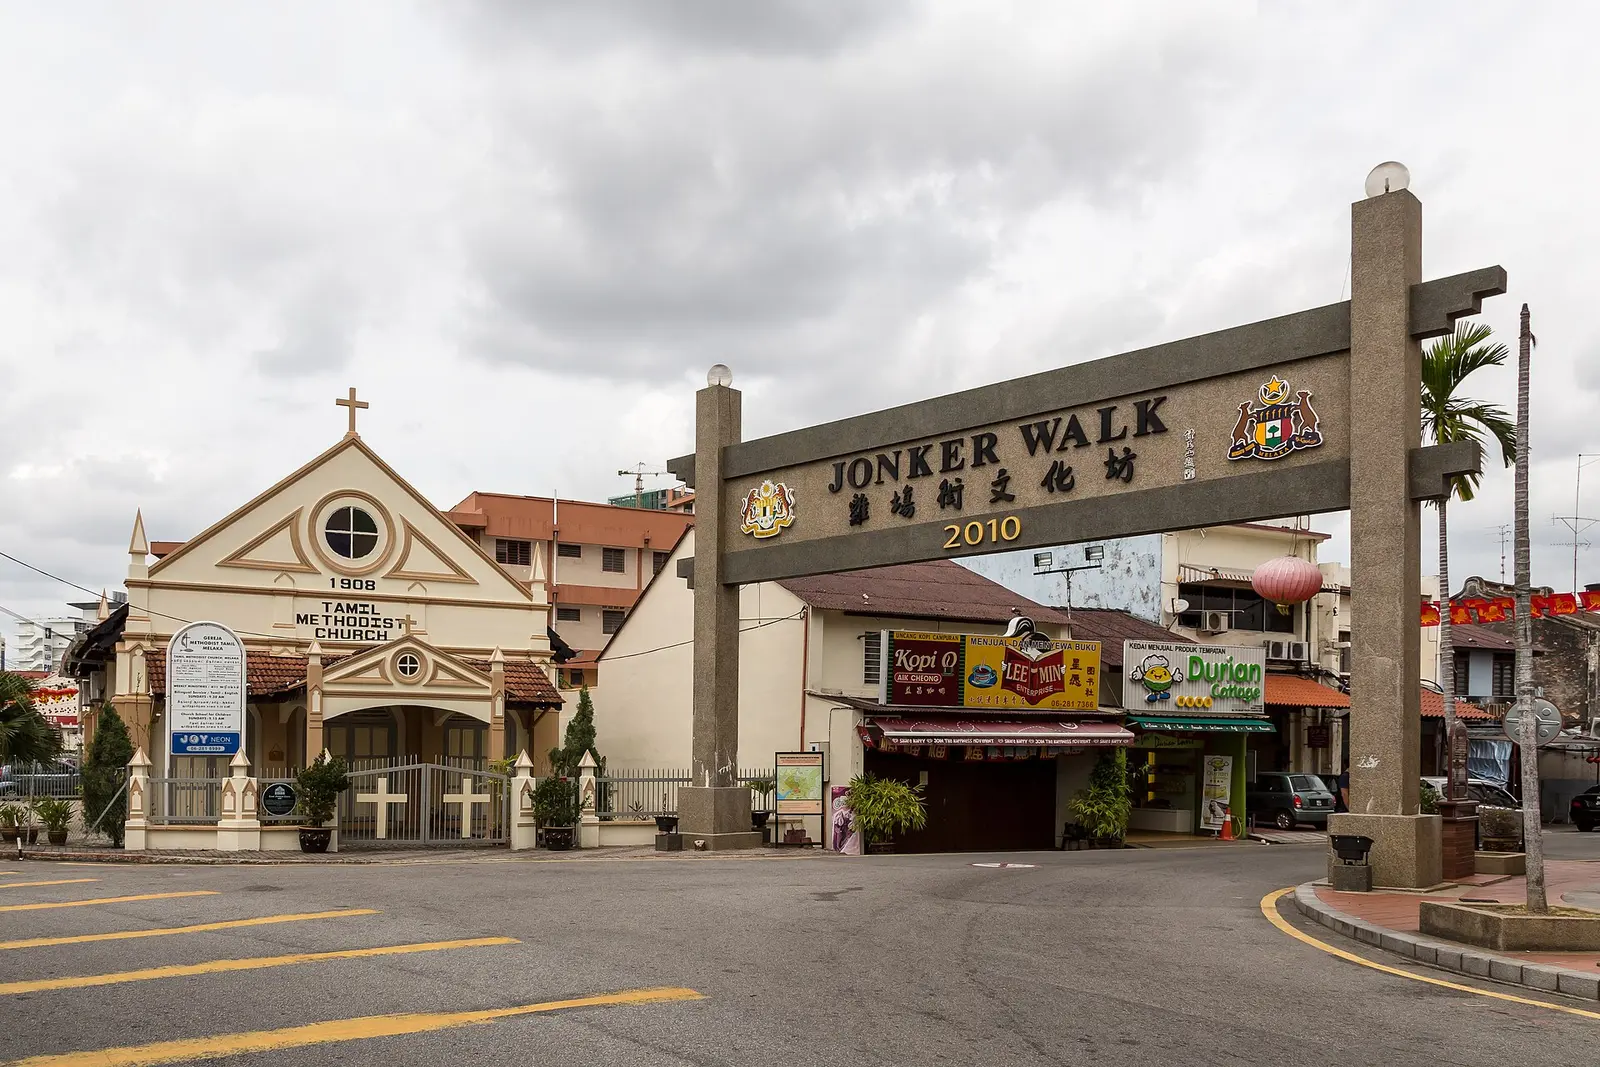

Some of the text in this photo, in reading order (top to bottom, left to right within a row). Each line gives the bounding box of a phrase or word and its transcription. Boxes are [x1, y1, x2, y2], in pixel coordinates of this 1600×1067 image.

[828, 432, 1000, 493] JONKER
[1018, 396, 1169, 457] WALK
[942, 516, 1021, 550] 2010
[330, 577, 376, 590] 1908
[321, 601, 381, 615] TAMIL
[296, 613, 406, 629] METHODIST
[315, 627, 388, 641] CHURCH
[895, 632, 917, 640] UNCANG
[932, 633, 959, 641] CAMPURAN
[970, 637, 1097, 652] MENJUAL DAN MENYEWA BUKU
[1129, 642, 1226, 655] KEDAI MENJUAL PRODUK TEMPATAN
[894, 648, 958, 672] Kopi O
[1005, 662, 1061, 684] LEE MIN
[1187, 655, 1261, 683] Durian
[910, 674, 940, 682] CHEONG
[1016, 683, 1054, 697] ENTERPRISE
[1210, 682, 1261, 702] Cottage
[1051, 699, 1094, 708] 06-281 7366
[179, 734, 208, 745] JOY
